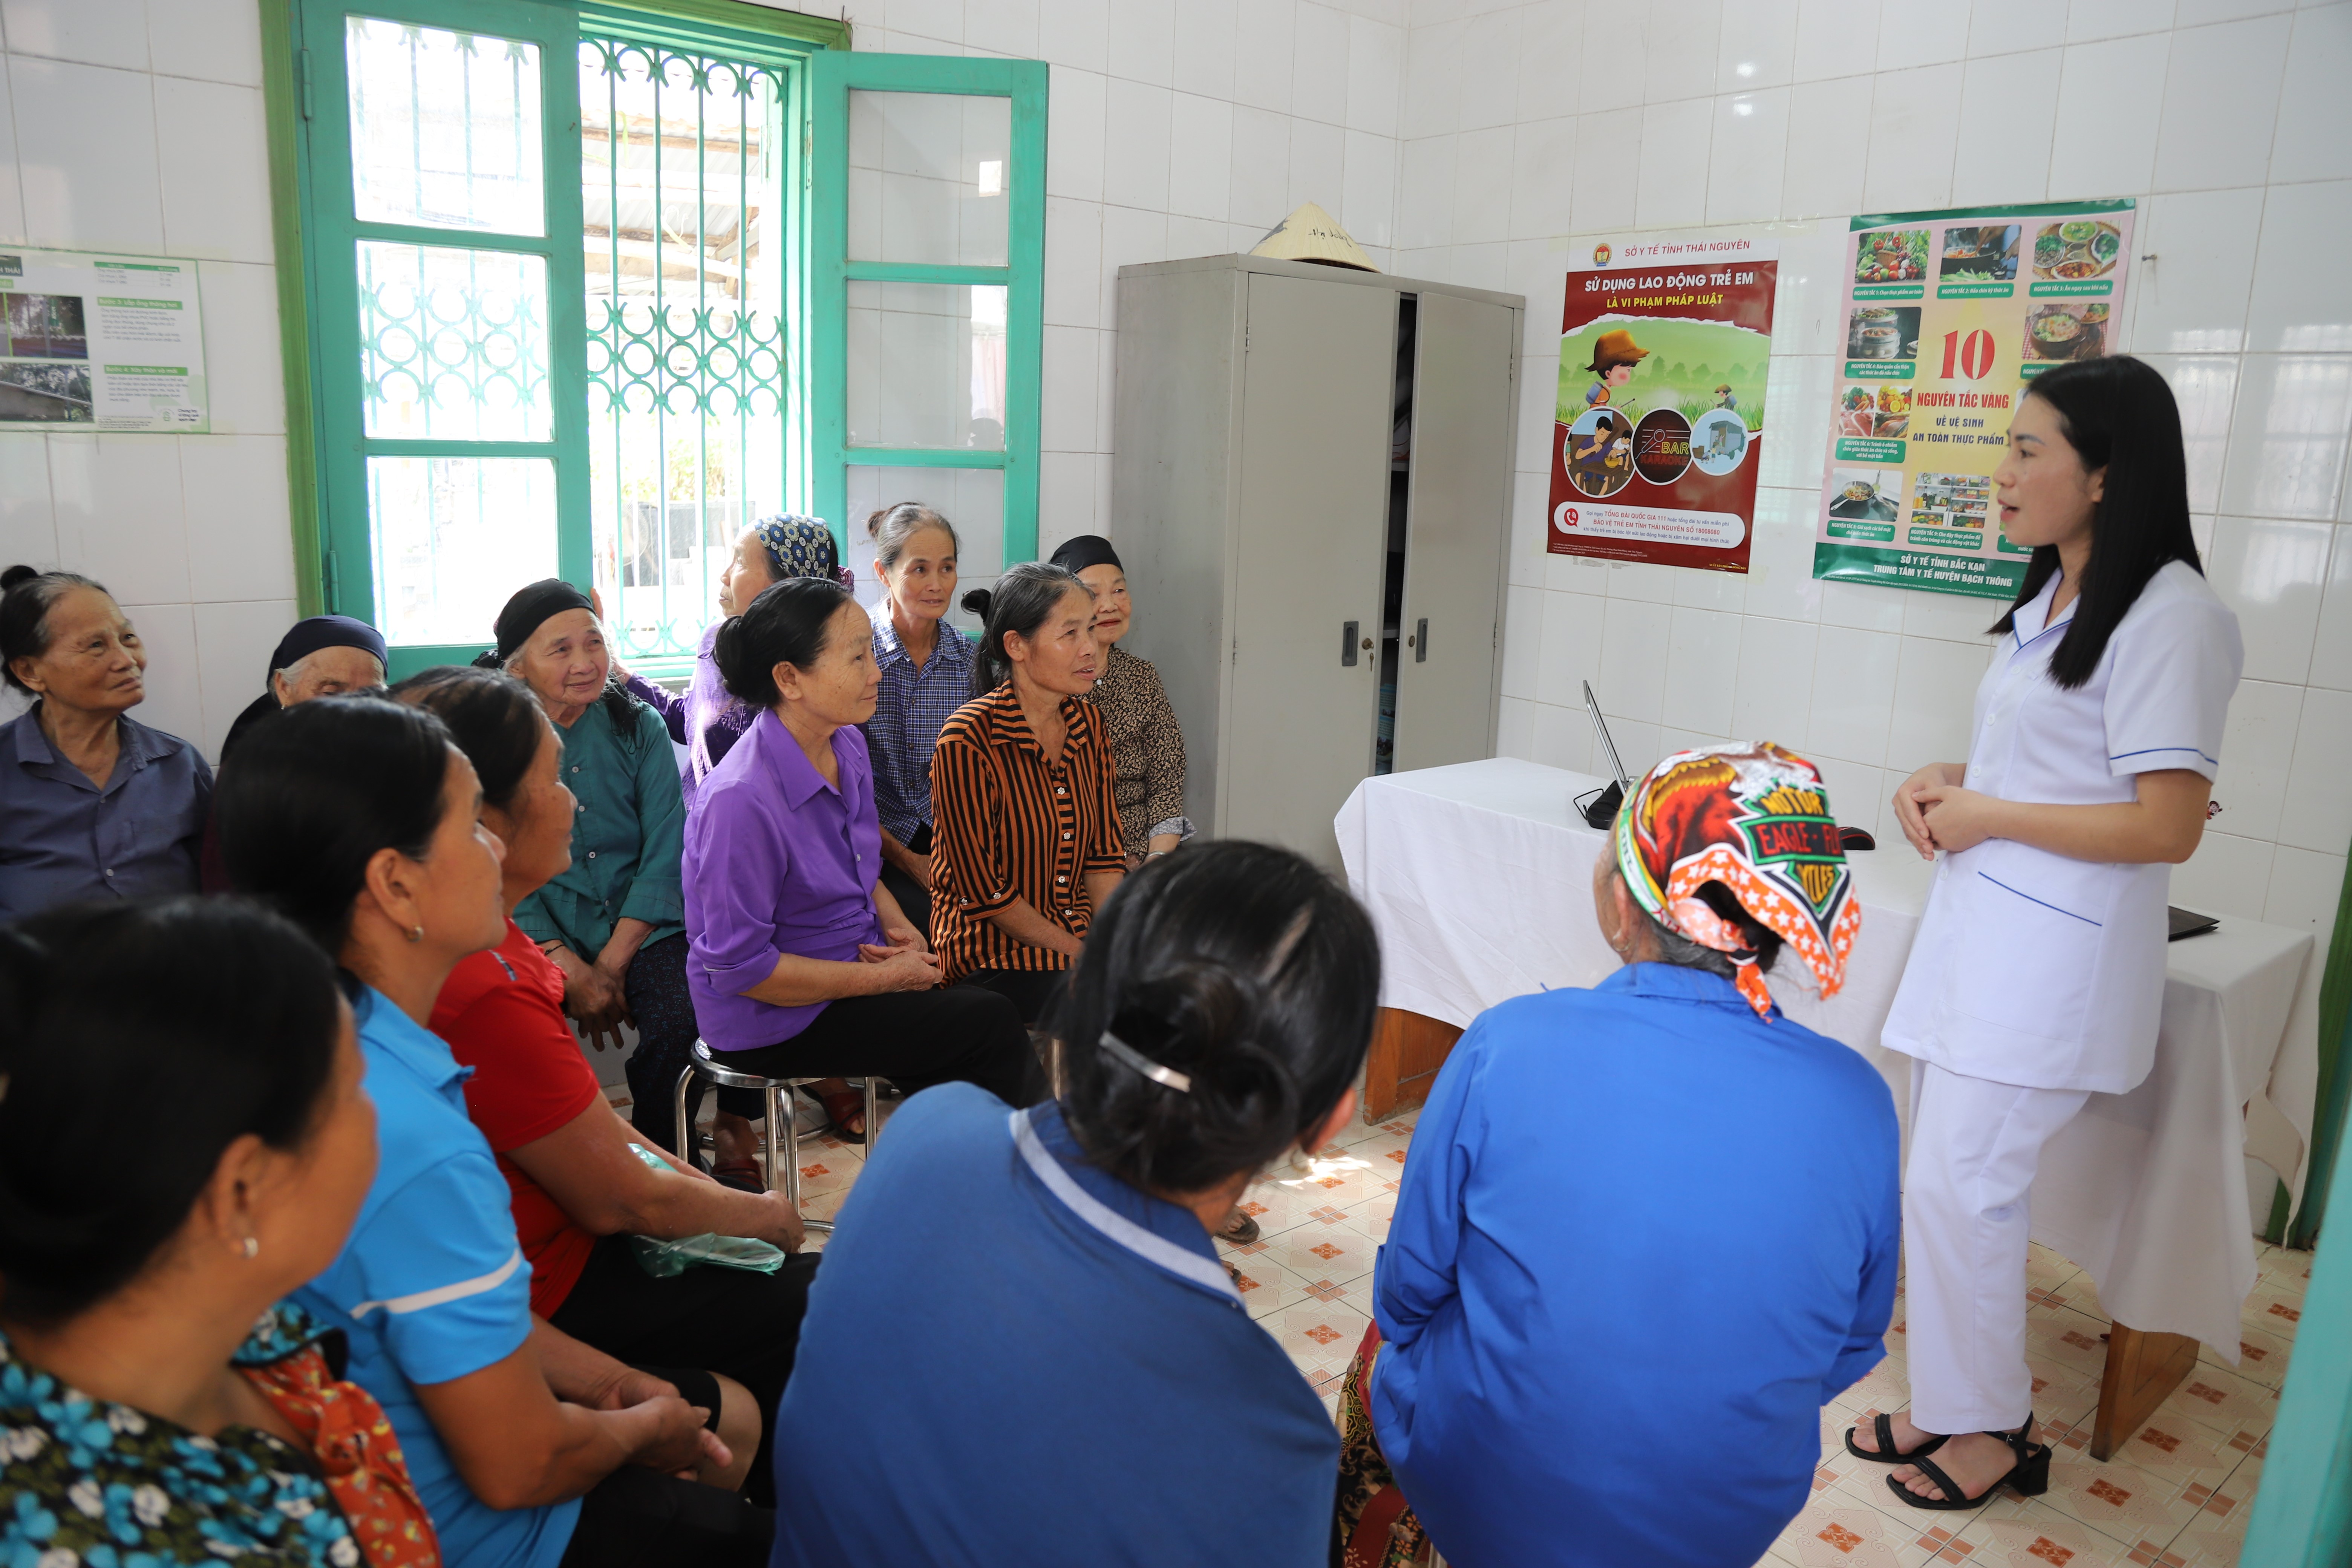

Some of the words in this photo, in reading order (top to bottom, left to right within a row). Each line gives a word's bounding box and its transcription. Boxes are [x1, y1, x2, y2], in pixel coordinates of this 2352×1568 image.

[1625, 245, 1637, 257] SỞ
[1648, 243, 1660, 255] TẾ
[1662, 242, 1683, 254] TỈNH
[1686, 241, 1707, 253] THÁI
[1709, 239, 1750, 251] NGUYÊN
[1585, 276, 1601, 292] SỬ
[1602, 278, 1636, 294] DỤNG
[1639, 276, 1663, 289] LAO
[1666, 272, 1706, 291] ĐỘNG
[1710, 268, 1732, 286] TRẺ
[1735, 272, 1753, 285] EM
[1607, 296, 1618, 308] LÀ
[1621, 298, 1631, 307] VI
[1634, 297, 1663, 309] PHẠM
[1666, 293, 1694, 306] PHÁP
[1697, 292, 1723, 307] LUẬT
[1939, 329, 1995, 380] 10
[1917, 391, 1955, 407] NGUYÊN
[1959, 389, 1978, 407] TẮC
[1982, 392, 2009, 408] VÀNG
[1937, 415, 1946, 426] VỀ
[1950, 416, 1960, 429] VỆ
[1963, 419, 1984, 427] SINH
[1913, 433, 1924, 441] AN
[1928, 432, 1948, 443] TOÀN
[1952, 435, 1974, 445] THỰC
[1977, 433, 2004, 445] PHẨM
[1661, 442, 1689, 455] BAR
[1641, 455, 1688, 465] KARAOKE
[1605, 509, 1619, 517] TỔNG
[1900, 553, 1912, 564] SỞ
[1913, 556, 1918, 565] Y
[1920, 555, 1930, 566] TẾ
[1930, 556, 1949, 568] TỈNH
[1950, 558, 1966, 570] BẮC
[1968, 562, 1985, 573] KẠN
[1874, 564, 1897, 574] TRUNG
[1899, 566, 1915, 576] TÂM
[1917, 569, 1922, 577] Y
[1923, 568, 1934, 578] TẾ
[1934, 571, 1960, 582] HUYỆN
[1962, 574, 1984, 584] BẠCH
[1985, 576, 2012, 587] THÔNG
